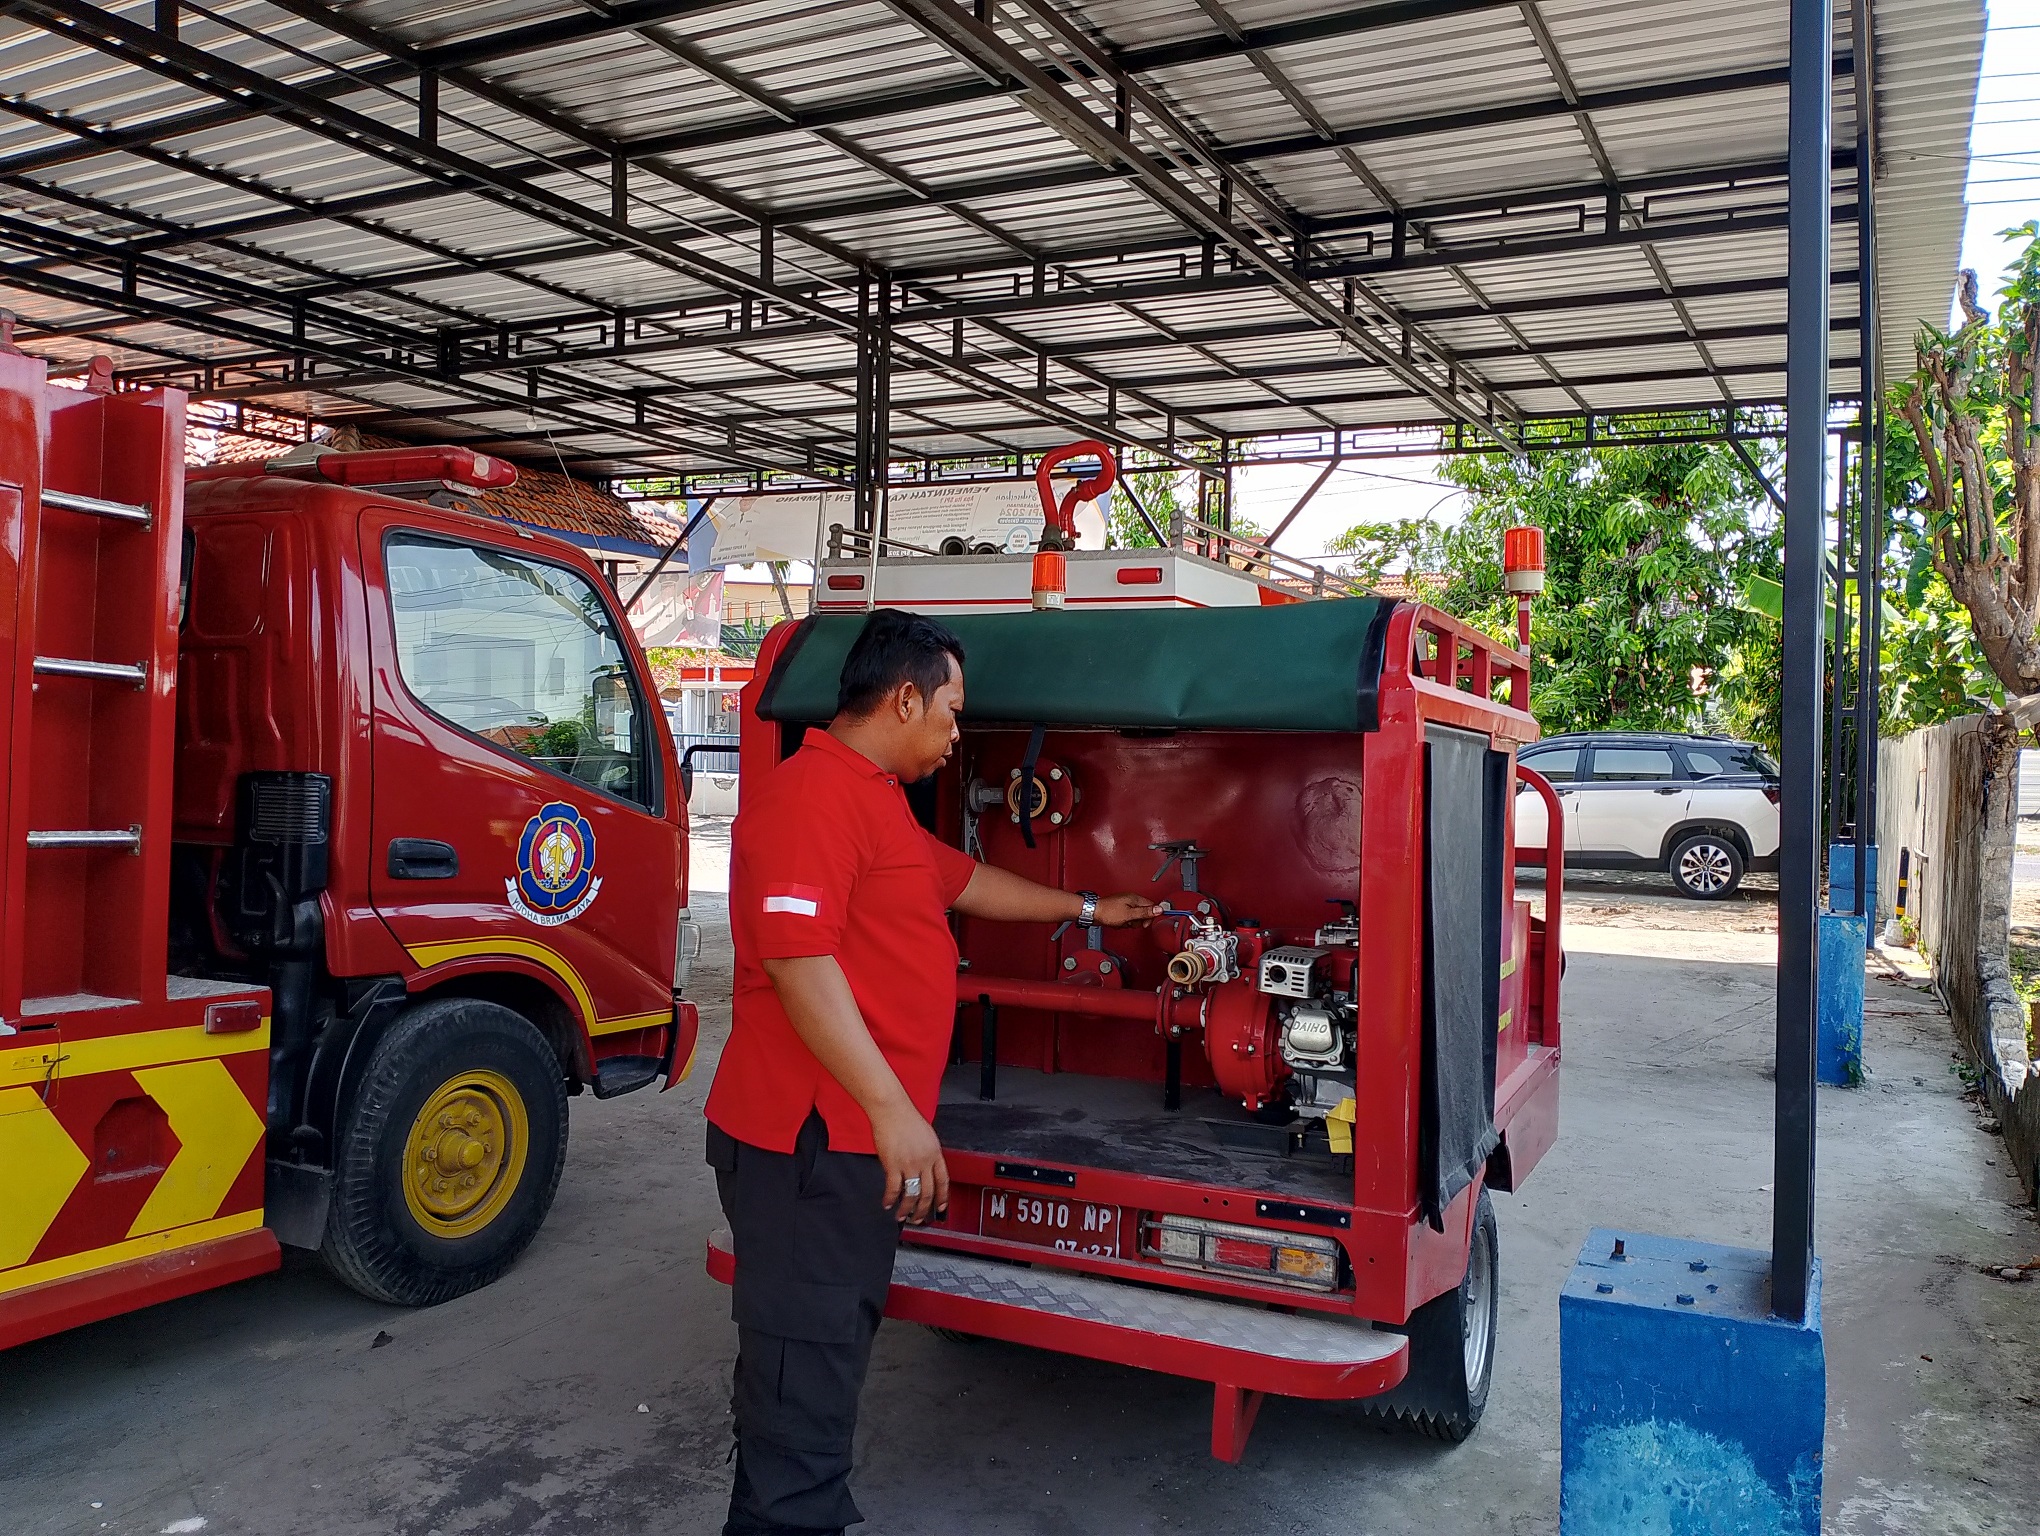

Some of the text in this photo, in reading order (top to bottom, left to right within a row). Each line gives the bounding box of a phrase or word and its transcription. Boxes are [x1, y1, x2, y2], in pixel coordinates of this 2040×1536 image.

[512, 898, 591, 925] YUDHA BRAMA JAYA
[1292, 1021, 1328, 1033] DAIHO
[990, 1194, 1111, 1232] M 5910 NP
